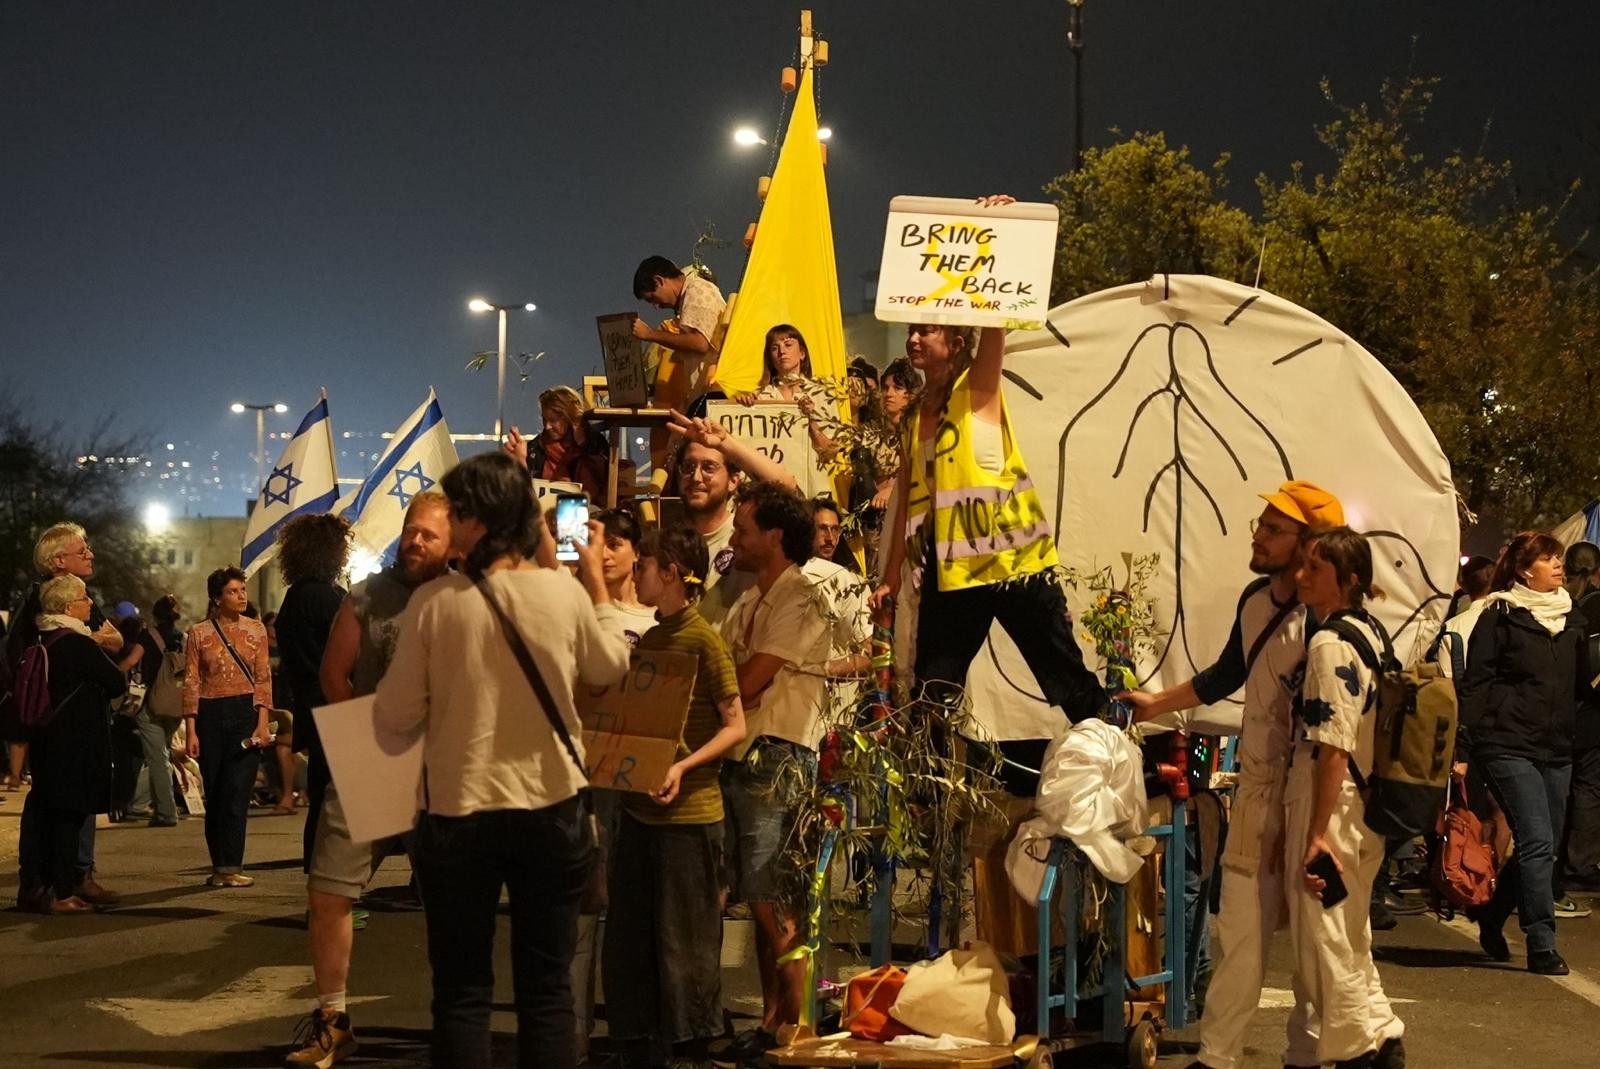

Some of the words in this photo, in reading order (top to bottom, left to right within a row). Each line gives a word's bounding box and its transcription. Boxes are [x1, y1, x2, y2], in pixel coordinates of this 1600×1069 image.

[901, 223, 997, 247] BRING
[919, 253, 995, 273] THEM
[960, 276, 1032, 295] BACK
[888, 295, 926, 305] STOP
[933, 298, 965, 308] THE
[970, 300, 1001, 310] WAR
